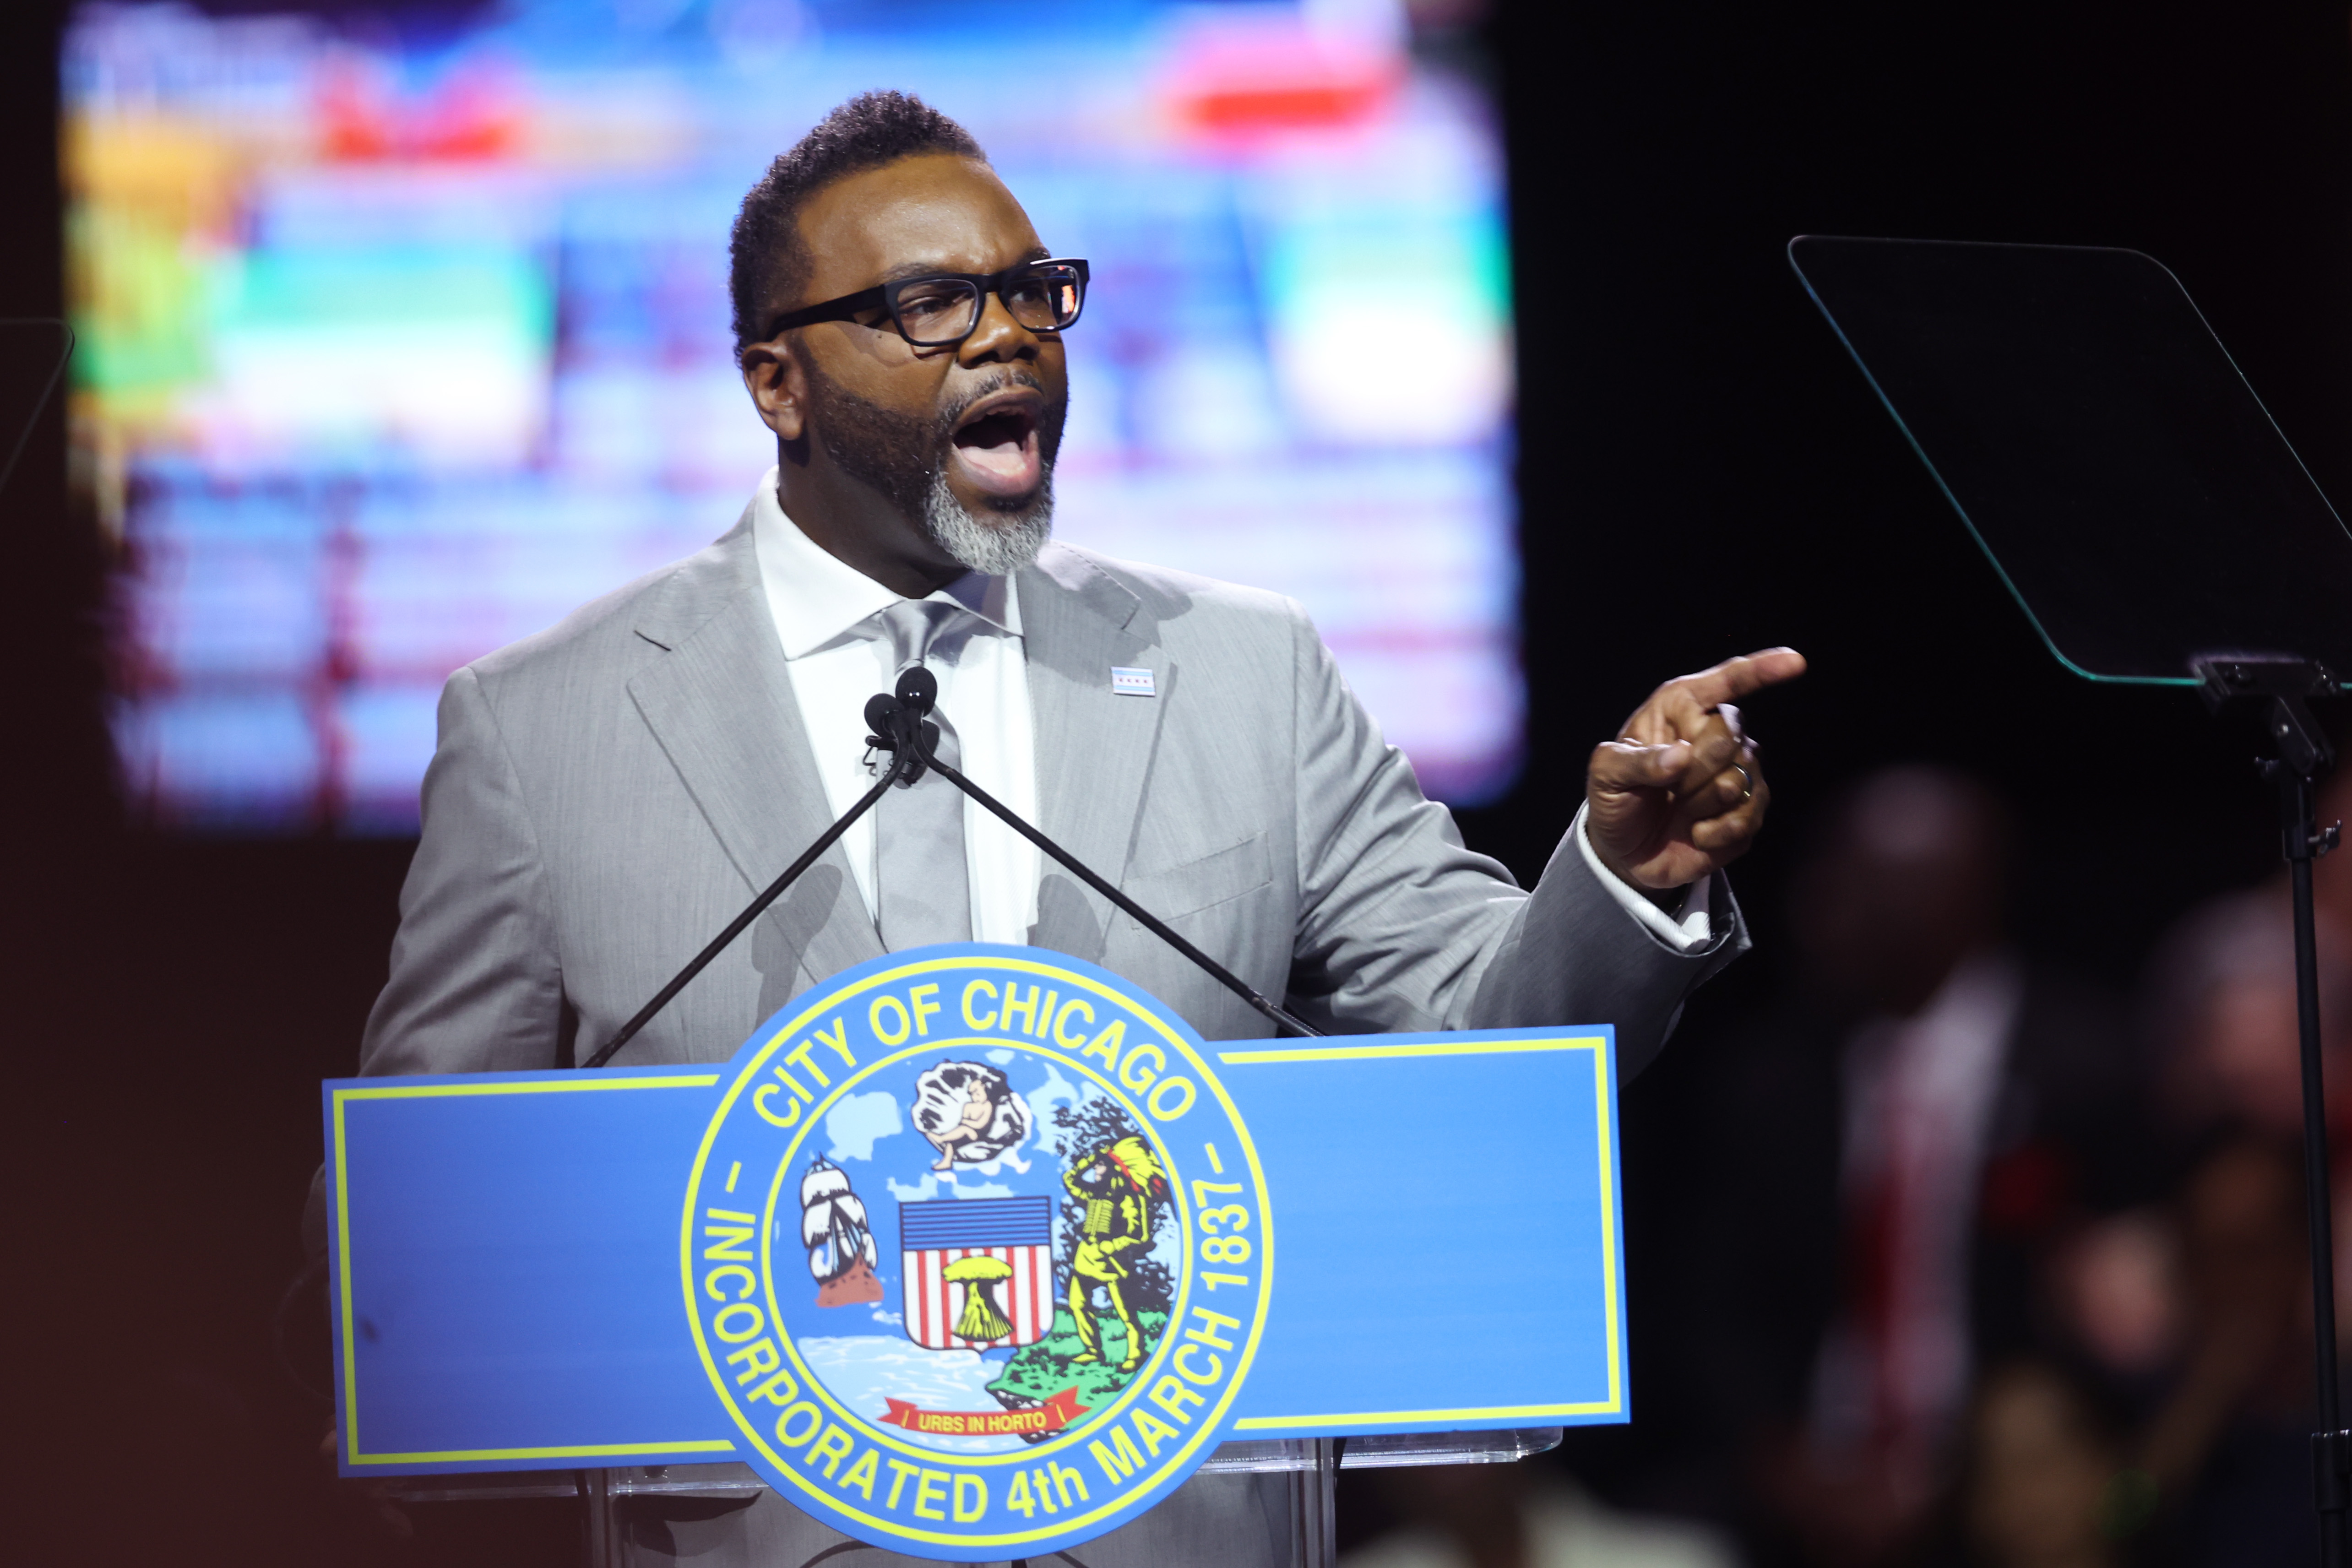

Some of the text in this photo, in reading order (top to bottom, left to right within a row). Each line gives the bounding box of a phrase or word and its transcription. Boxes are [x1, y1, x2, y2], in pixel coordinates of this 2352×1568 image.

[753, 979, 1196, 1128] CITY OF CHICAGO
[704, 1179, 1251, 1523] INCORPORATED 4th MARCH 1837
[918, 1411, 1047, 1432] URBS IN HORTO
